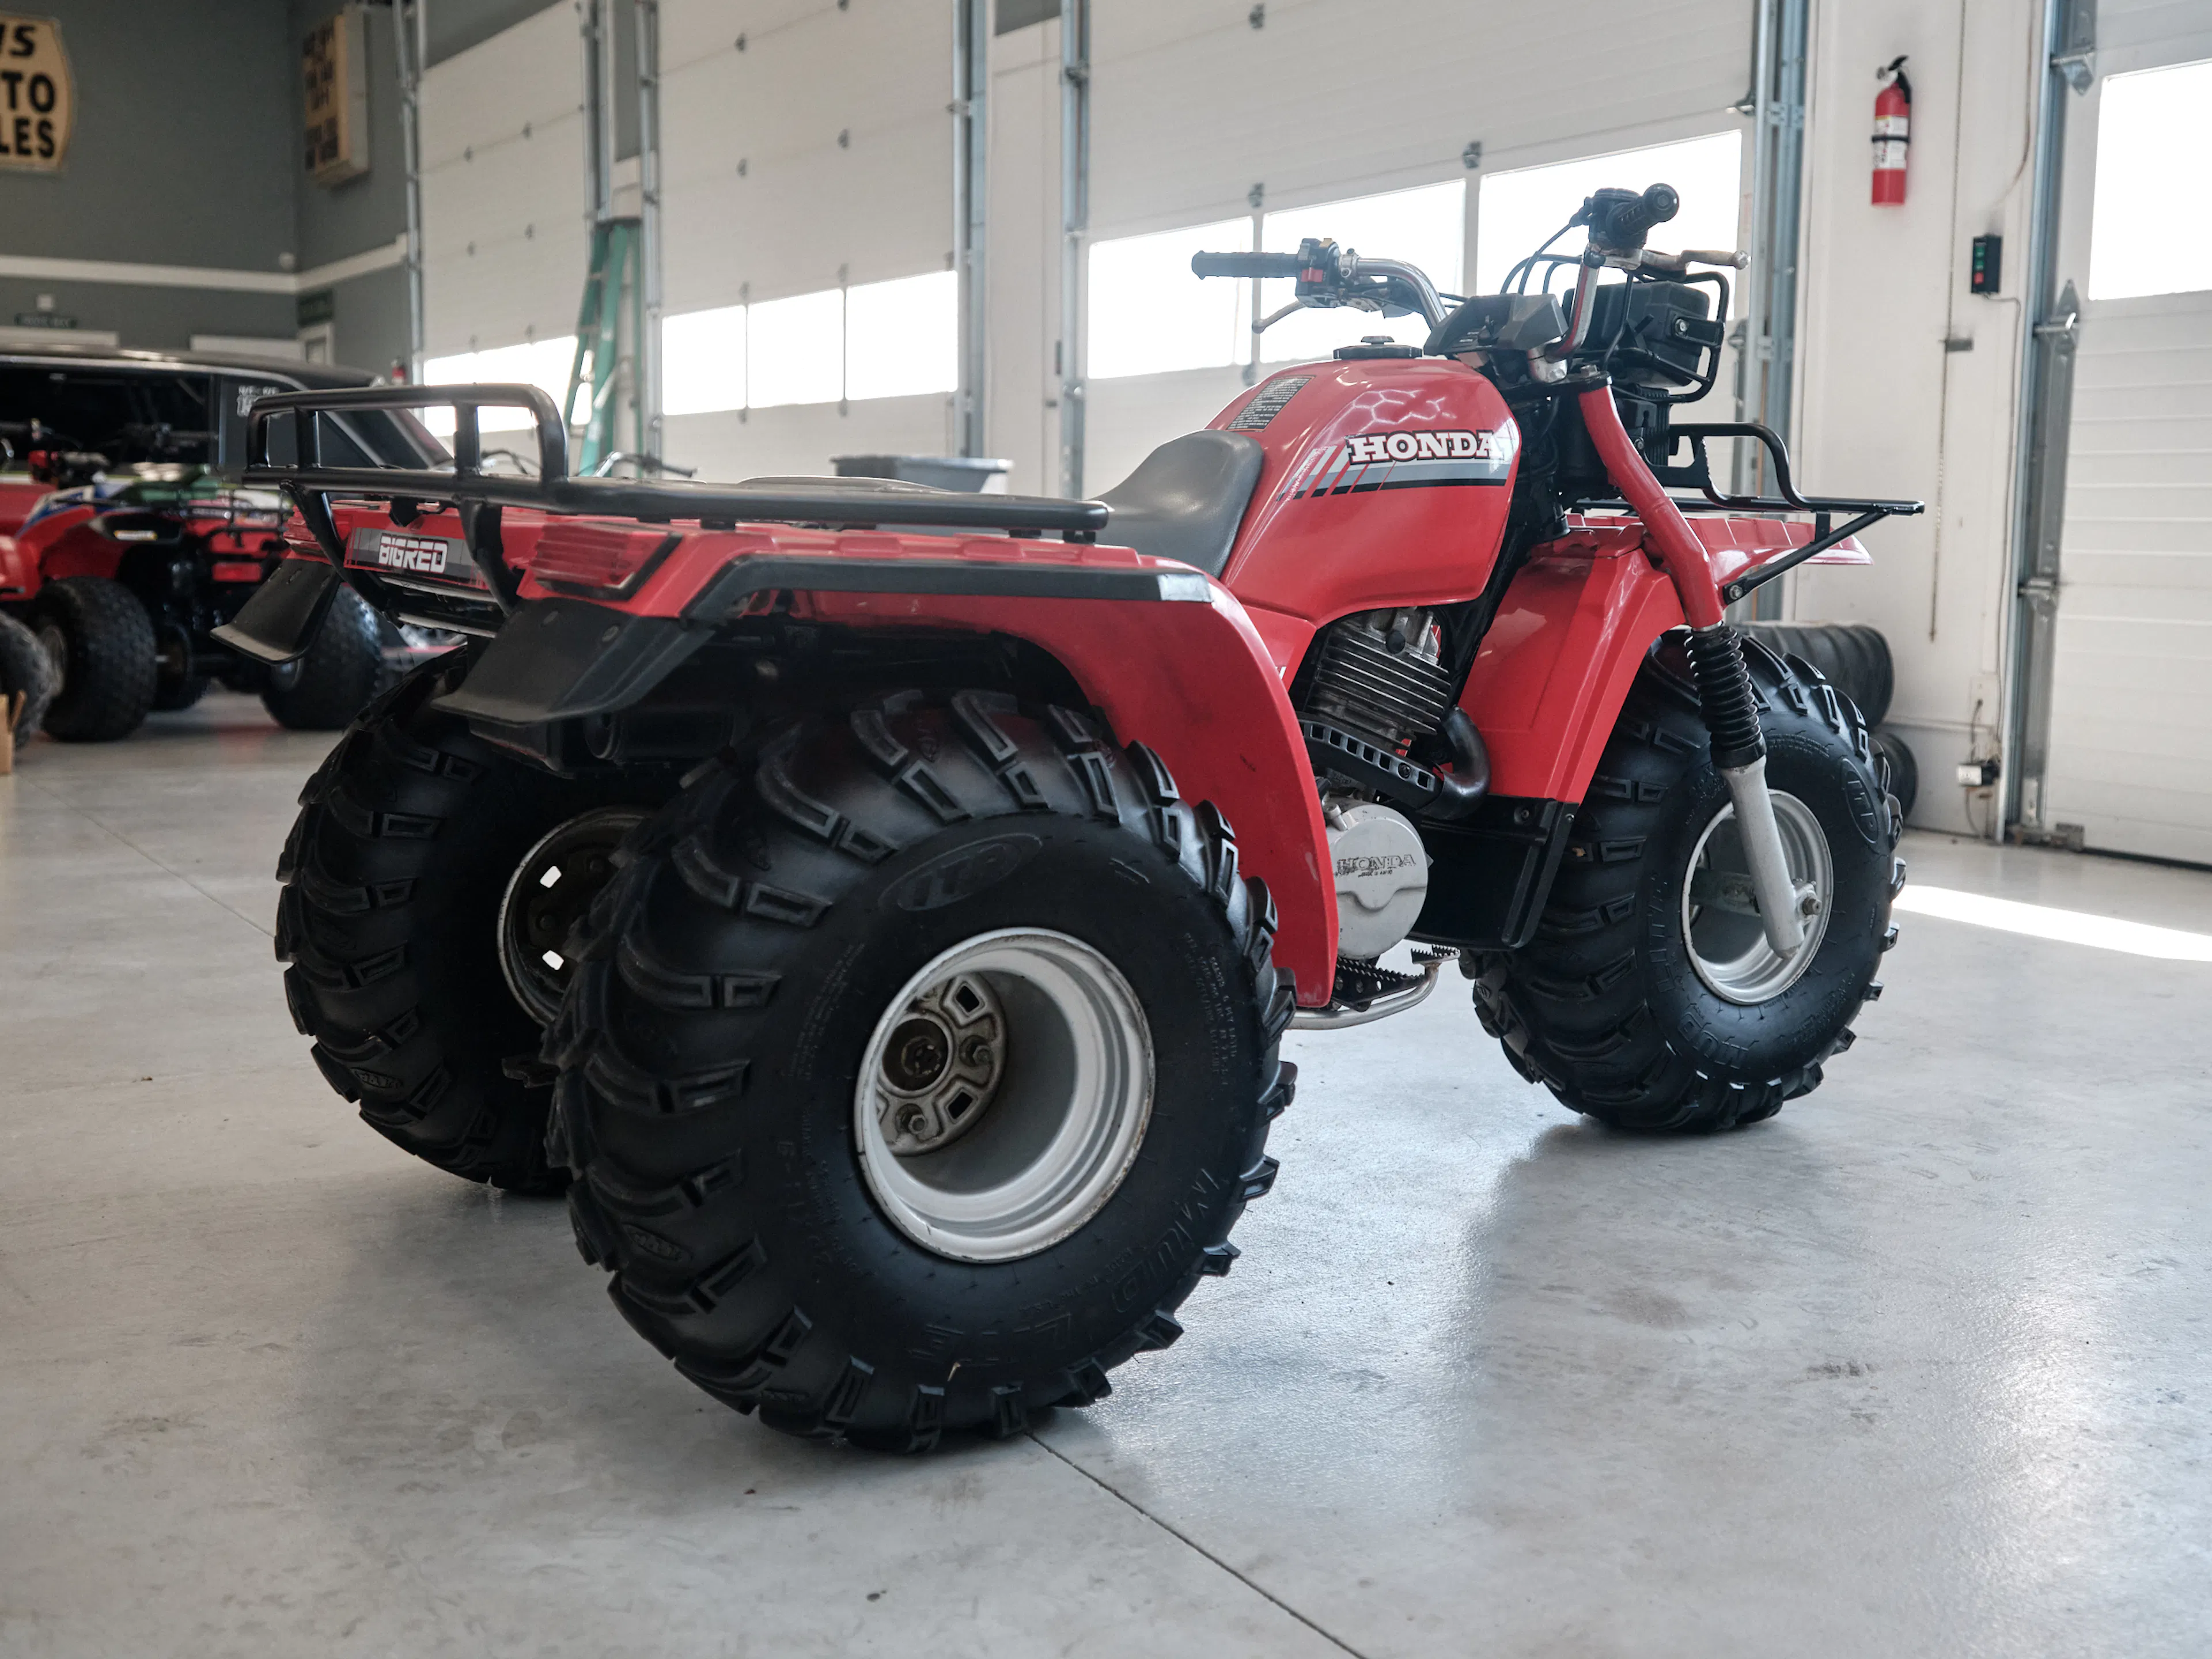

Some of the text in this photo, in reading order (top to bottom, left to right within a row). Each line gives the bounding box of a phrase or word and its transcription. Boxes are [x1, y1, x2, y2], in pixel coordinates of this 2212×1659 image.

[1, 71, 55, 113] TO
[1345, 430, 1505, 464] HONDA
[377, 533, 448, 574] BIGRED
[1847, 779, 1876, 832] ITP
[1336, 854, 1416, 873] HONDA
[1677, 1012, 1749, 1070] MUD
[1111, 1168, 1220, 1313] MUD
